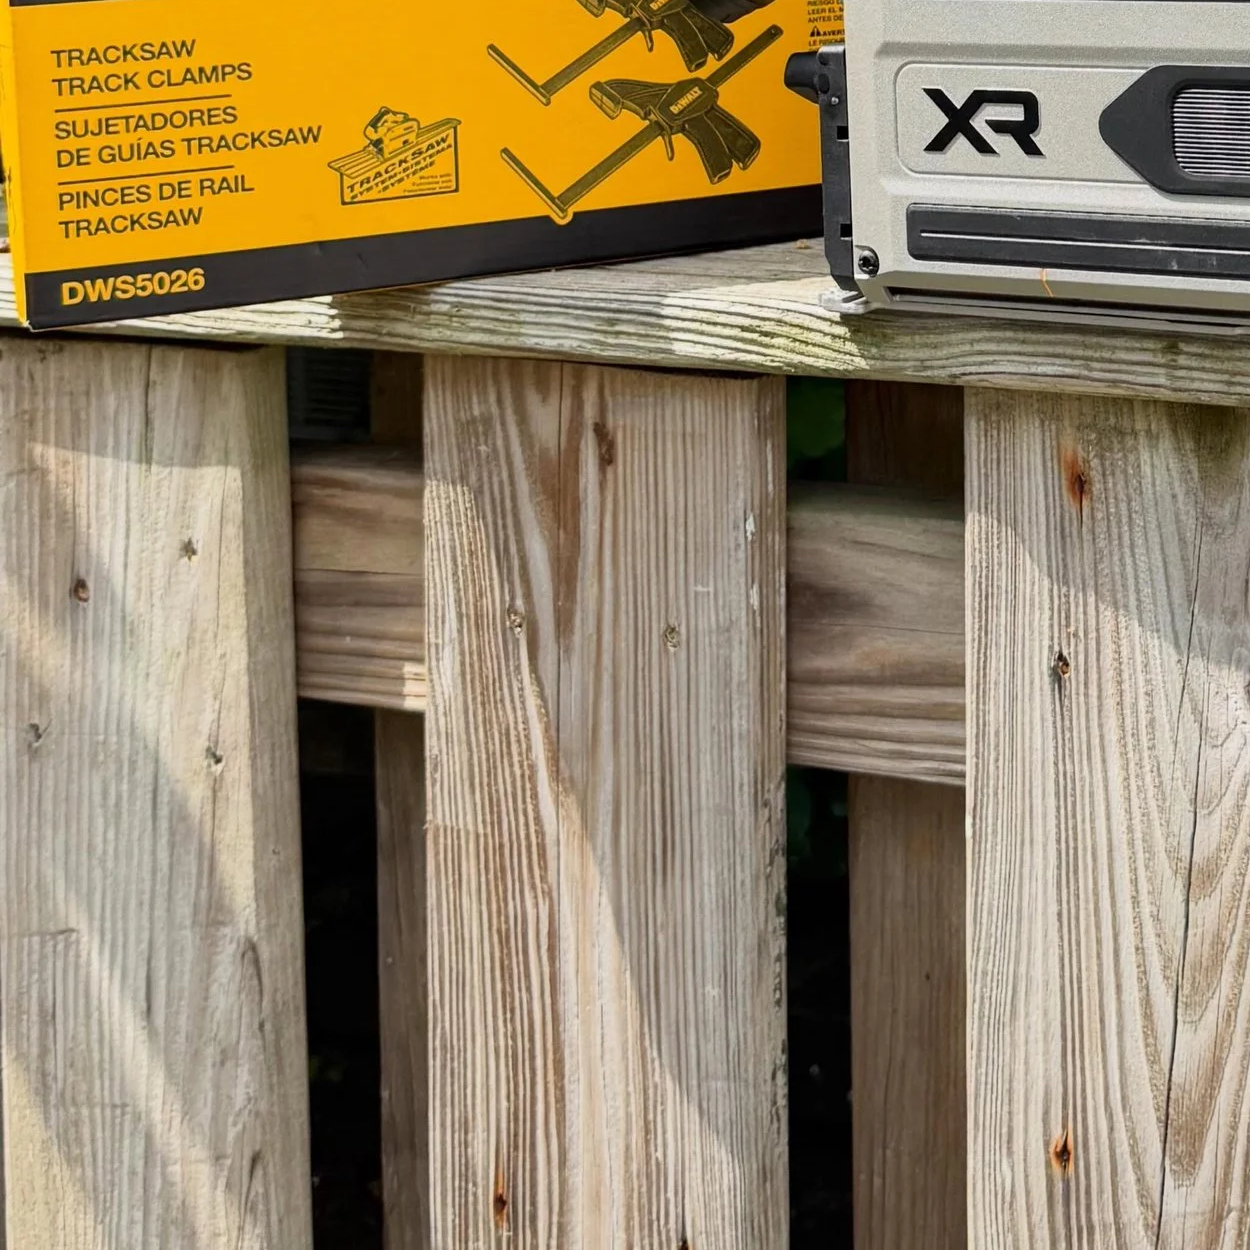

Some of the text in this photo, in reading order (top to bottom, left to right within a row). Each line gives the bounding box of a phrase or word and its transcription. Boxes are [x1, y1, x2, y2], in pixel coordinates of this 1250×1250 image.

[50, 39, 196, 68] TRACKSAW
[52, 62, 253, 97] TRACK CLAMPS
[54, 106, 238, 140] SUJETADORES
[922, 88, 1044, 156] XR
[56, 125, 322, 168] DE GUÍAS TRACKSAW
[347, 134, 450, 193] TRACKSAW
[58, 174, 255, 211] PINCES DE RAIL
[59, 207, 203, 239] TRACKSAW
[61, 267, 206, 306] DWS5026
